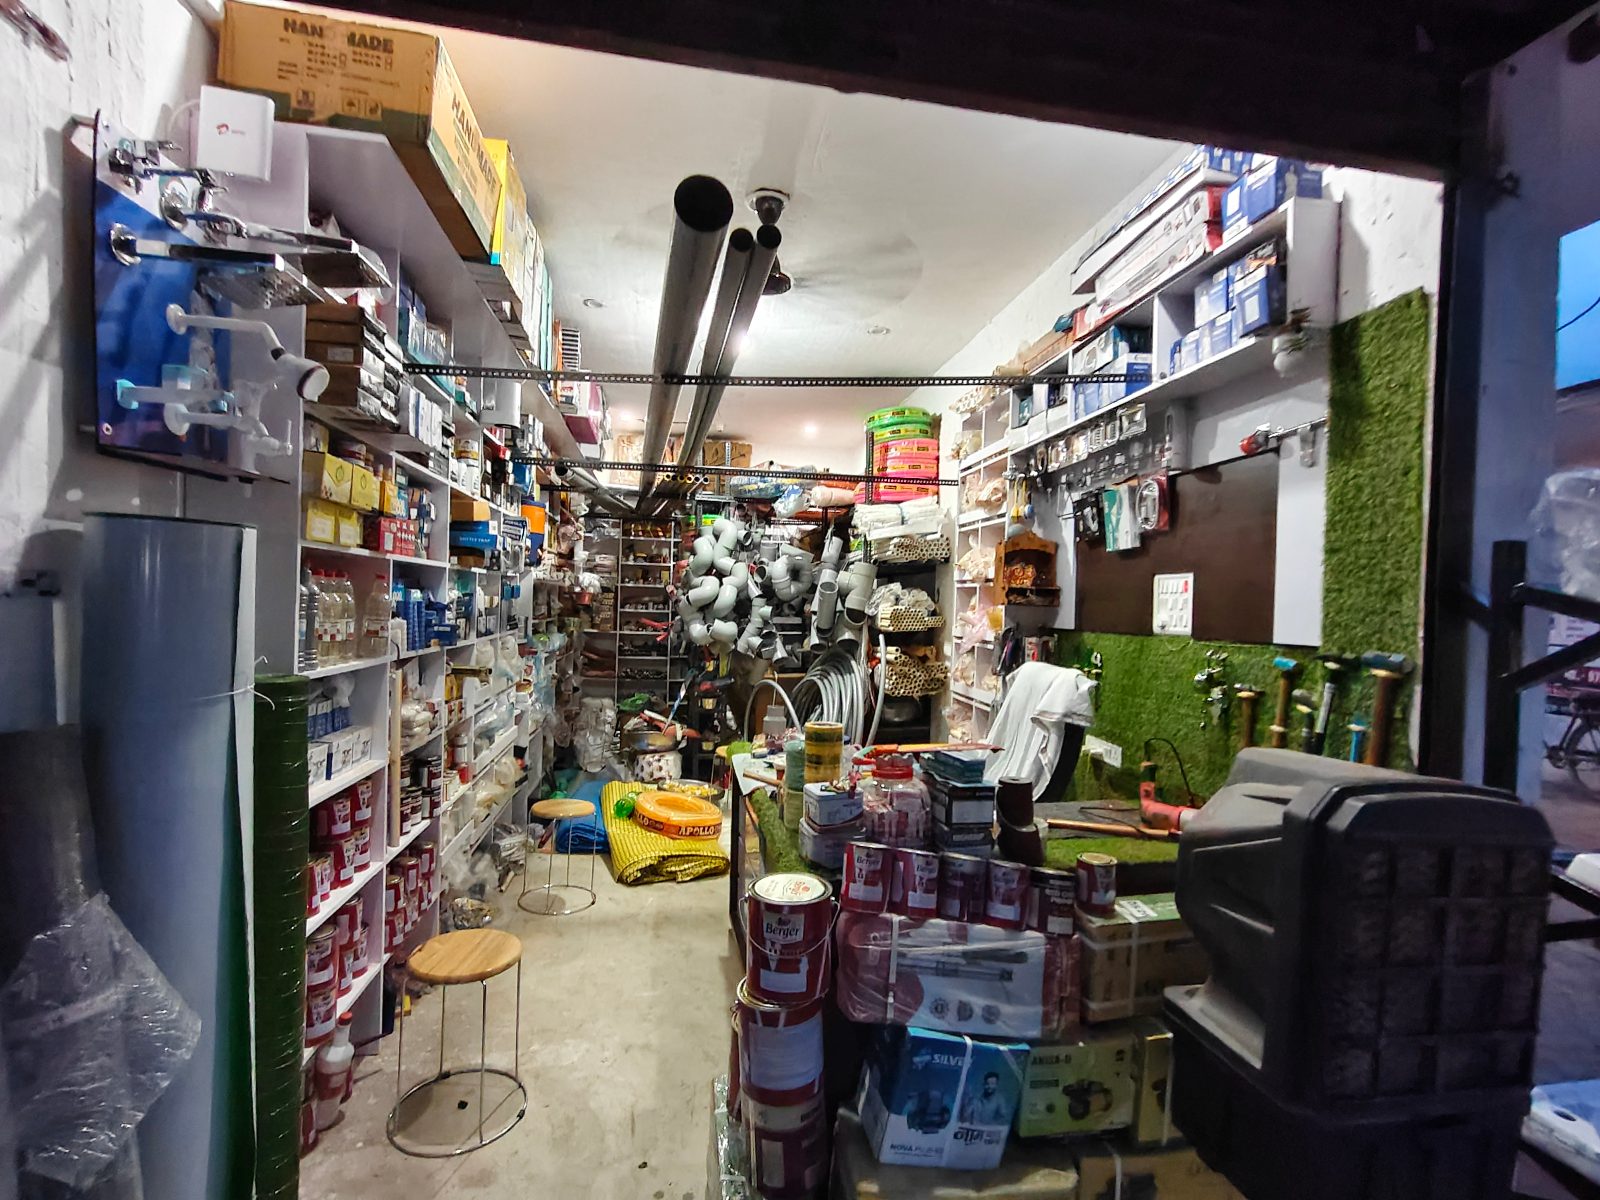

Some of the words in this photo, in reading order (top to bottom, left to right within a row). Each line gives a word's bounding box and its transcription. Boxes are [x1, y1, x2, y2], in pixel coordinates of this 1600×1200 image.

[678, 825, 715, 837] APOLLO
[765, 922, 800, 938] Berger
[931, 1053, 973, 1067] SILVE
